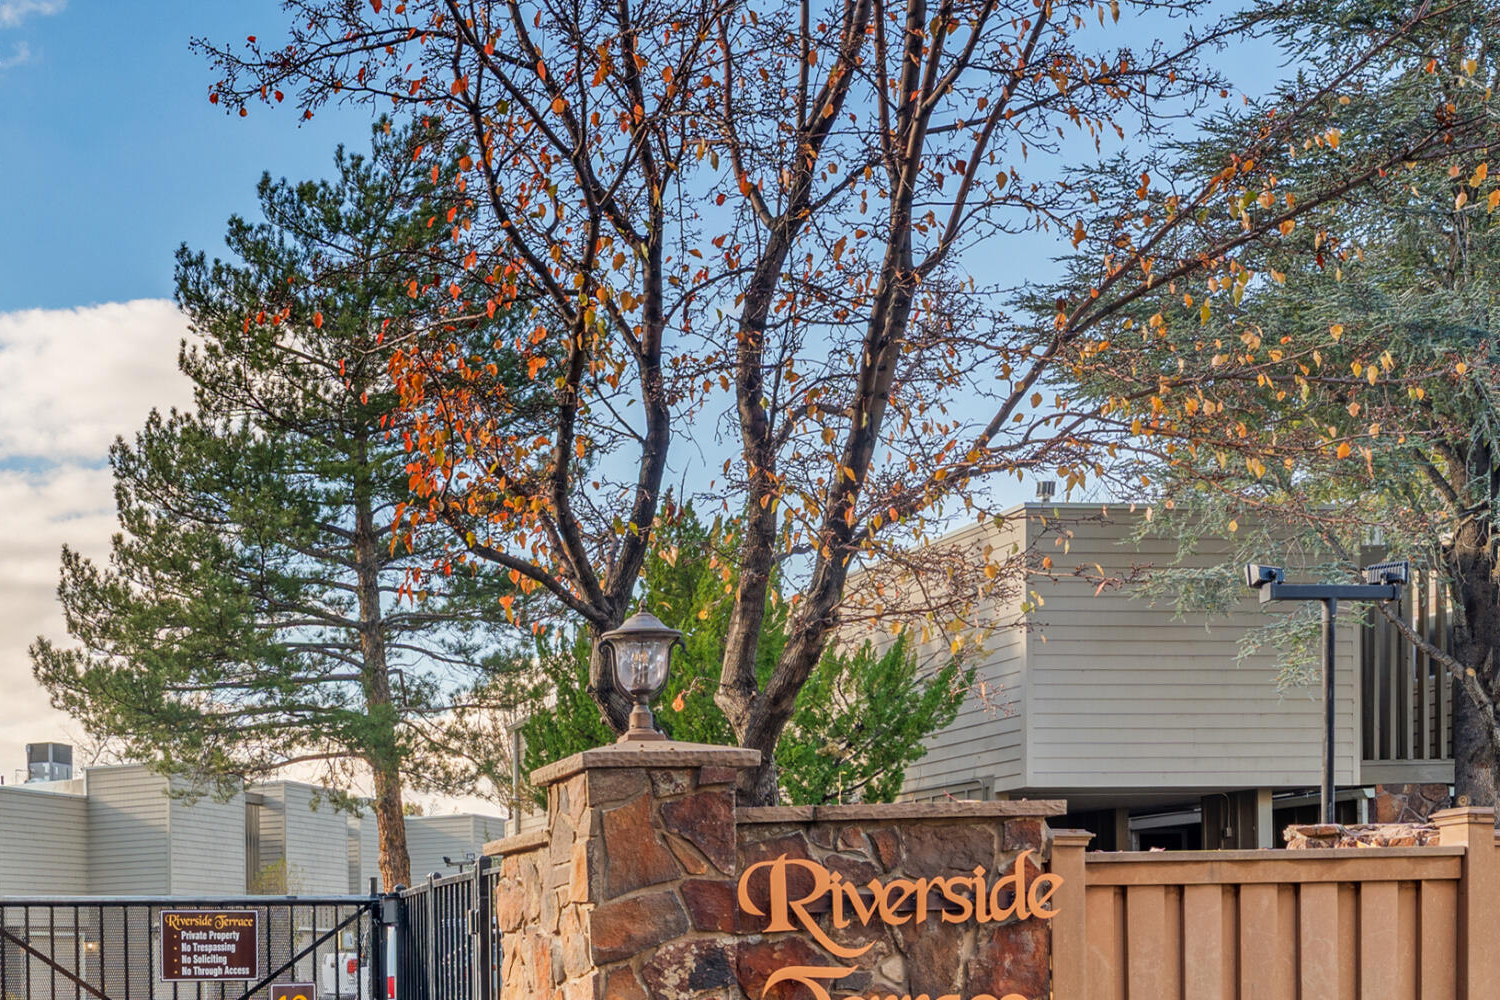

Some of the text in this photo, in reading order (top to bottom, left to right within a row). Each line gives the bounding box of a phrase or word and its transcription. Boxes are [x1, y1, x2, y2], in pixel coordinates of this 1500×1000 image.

[737, 848, 1065, 959] Riverside
[164, 914, 254, 931] Riverside Terrace
[181, 930, 240, 942] Private Property
[181, 942, 236, 953] No Trespassing
[181, 954, 228, 965] No Soliciting
[181, 966, 250, 977] No Through Access
